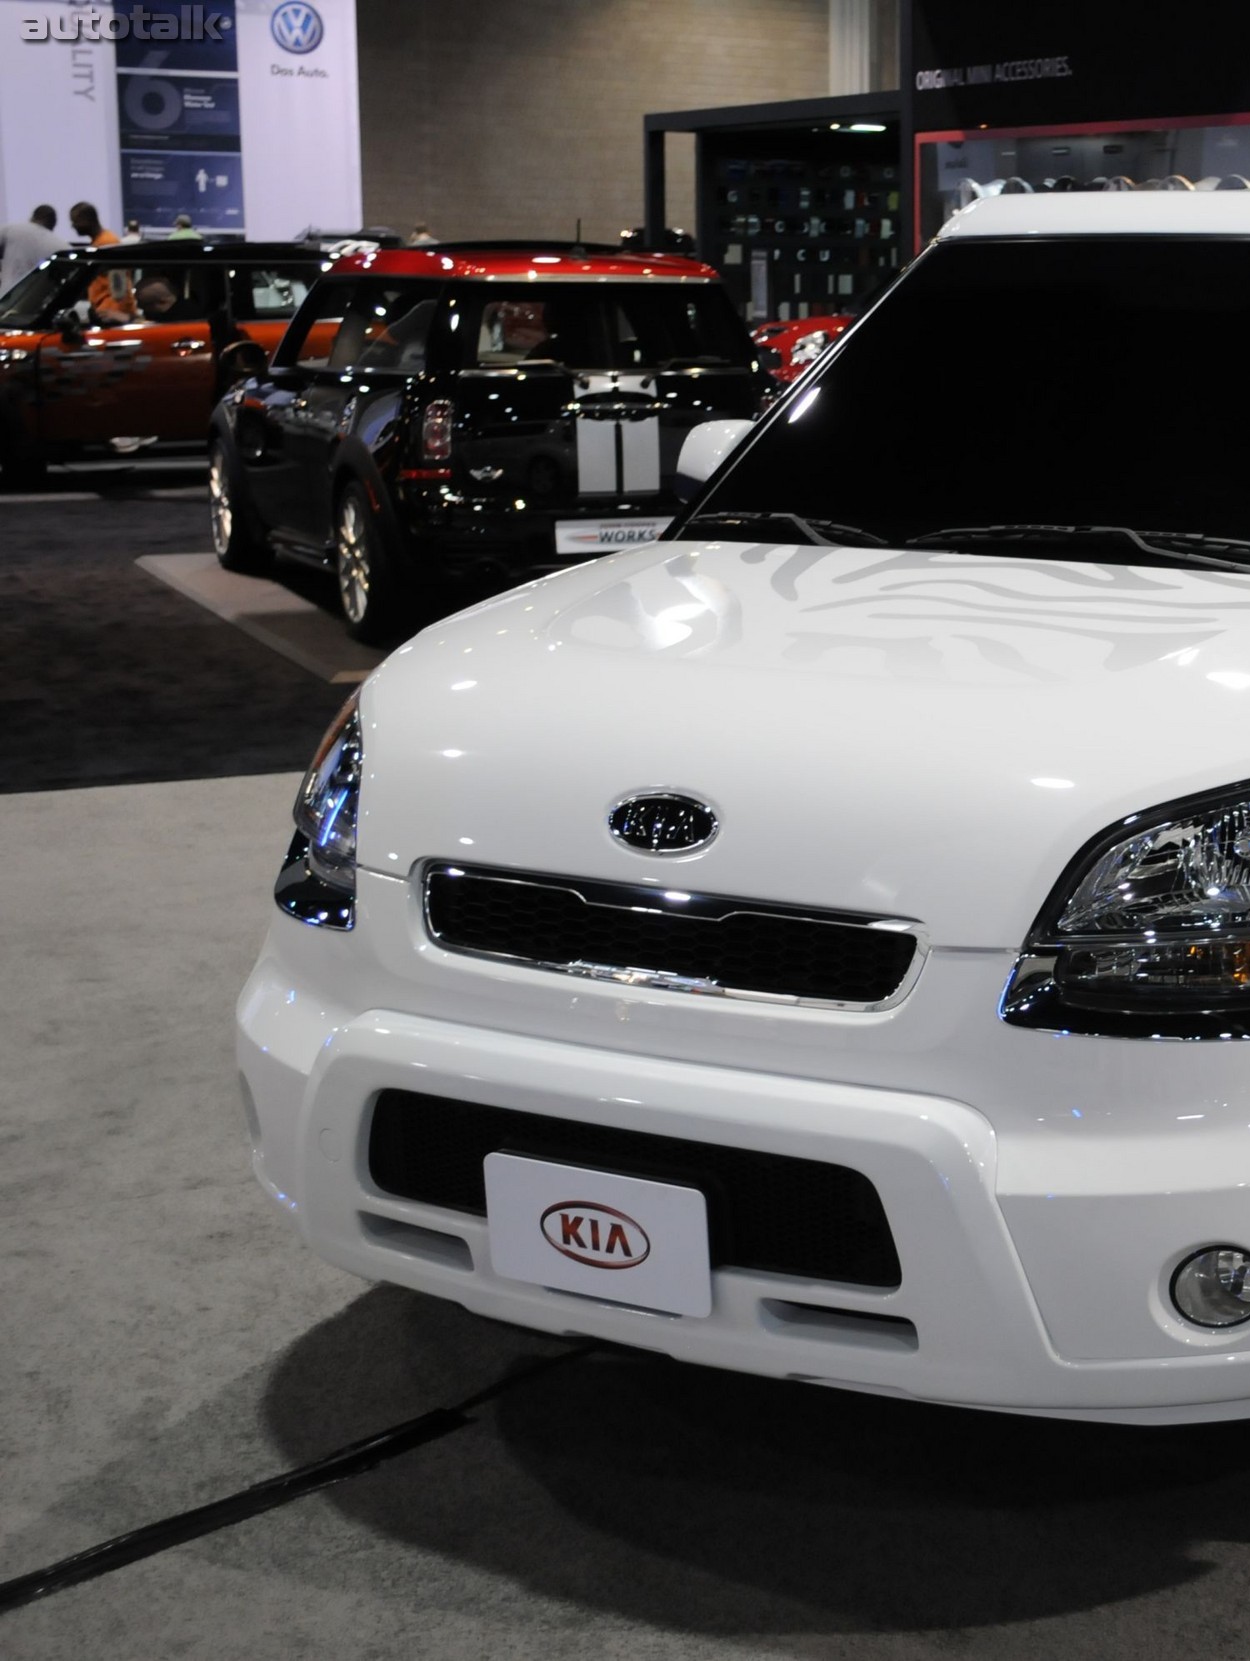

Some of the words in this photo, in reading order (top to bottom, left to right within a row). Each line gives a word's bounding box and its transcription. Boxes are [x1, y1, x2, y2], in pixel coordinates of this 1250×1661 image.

[271, 63, 294, 76] Das
[599, 529, 657, 544] WORKS
[559, 1213, 633, 1258] KIA
